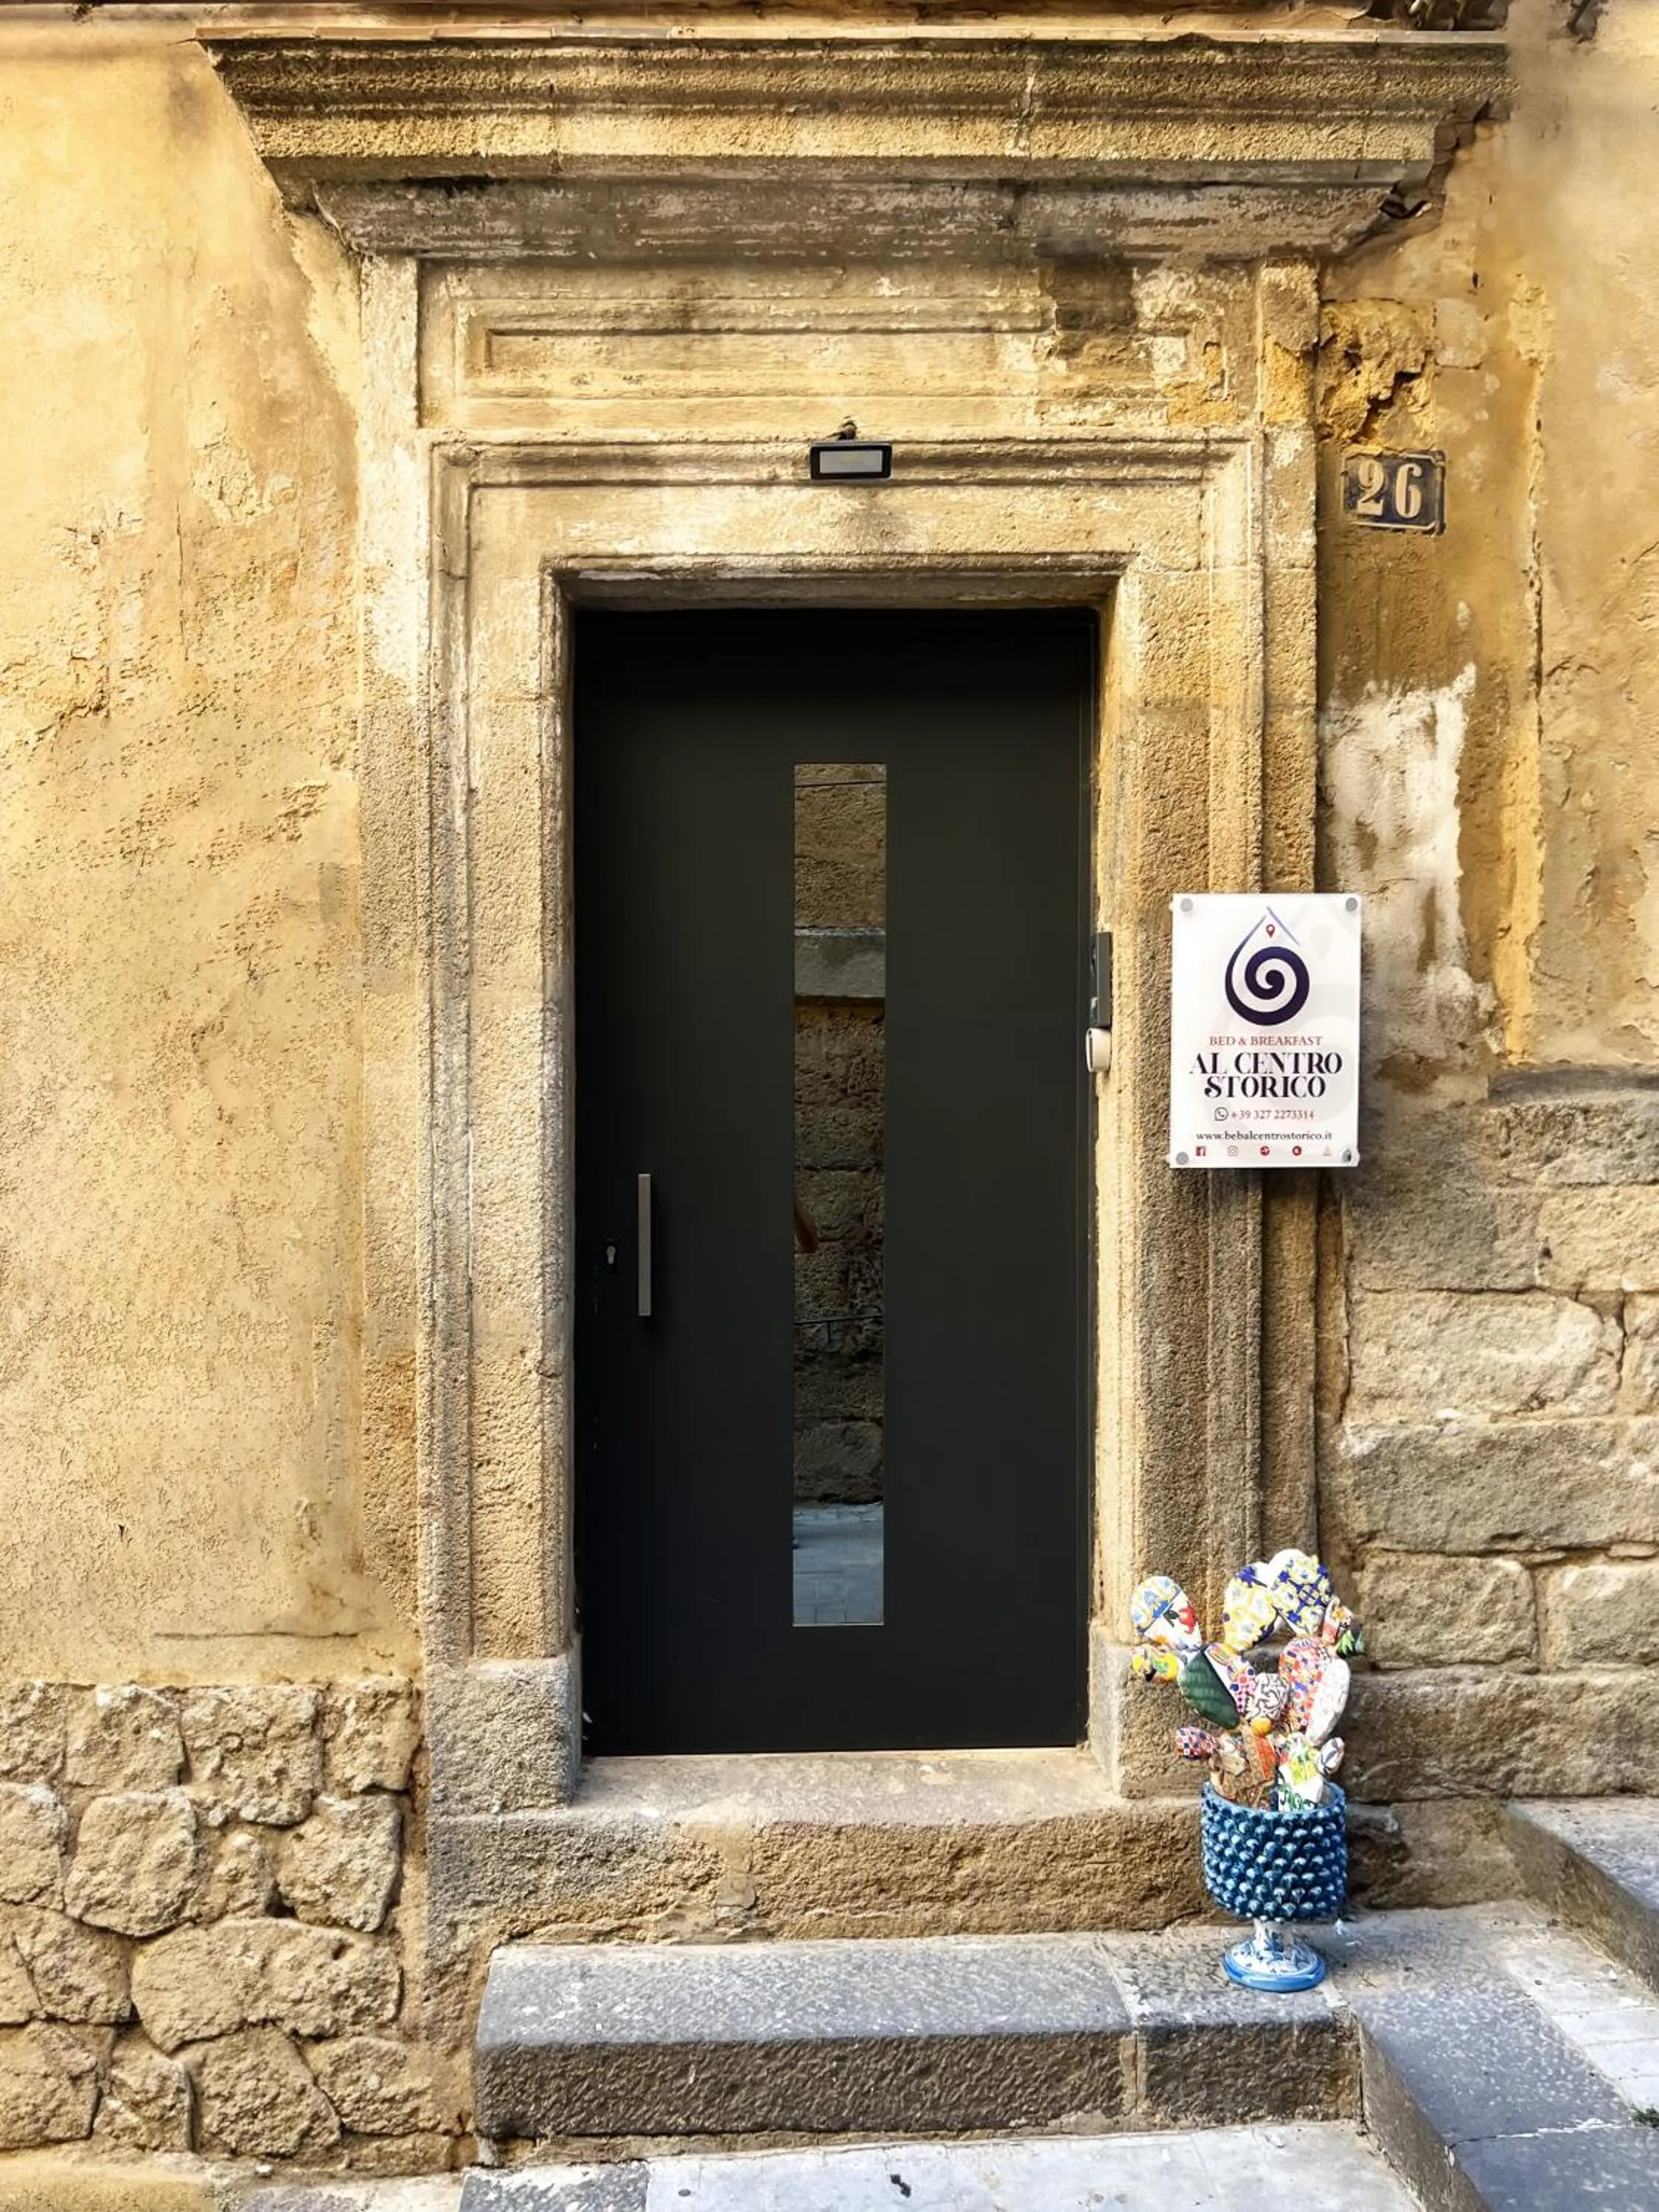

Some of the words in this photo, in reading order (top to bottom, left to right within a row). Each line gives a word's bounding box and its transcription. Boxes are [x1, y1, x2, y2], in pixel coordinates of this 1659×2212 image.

[1356, 458, 1422, 518] 26
[1210, 1036, 1236, 1046] BED
[1238, 1036, 1248, 1046] &
[1251, 1036, 1323, 1046] BREAKFAST
[1189, 1052, 1228, 1074] AL
[1234, 1052, 1343, 1074] CENTRO
[1204, 1076, 1326, 1098] STORICO
[1253, 1110, 1272, 1119] 327
[1196, 1130, 1332, 1141] www.bebalcentrostorico.it
